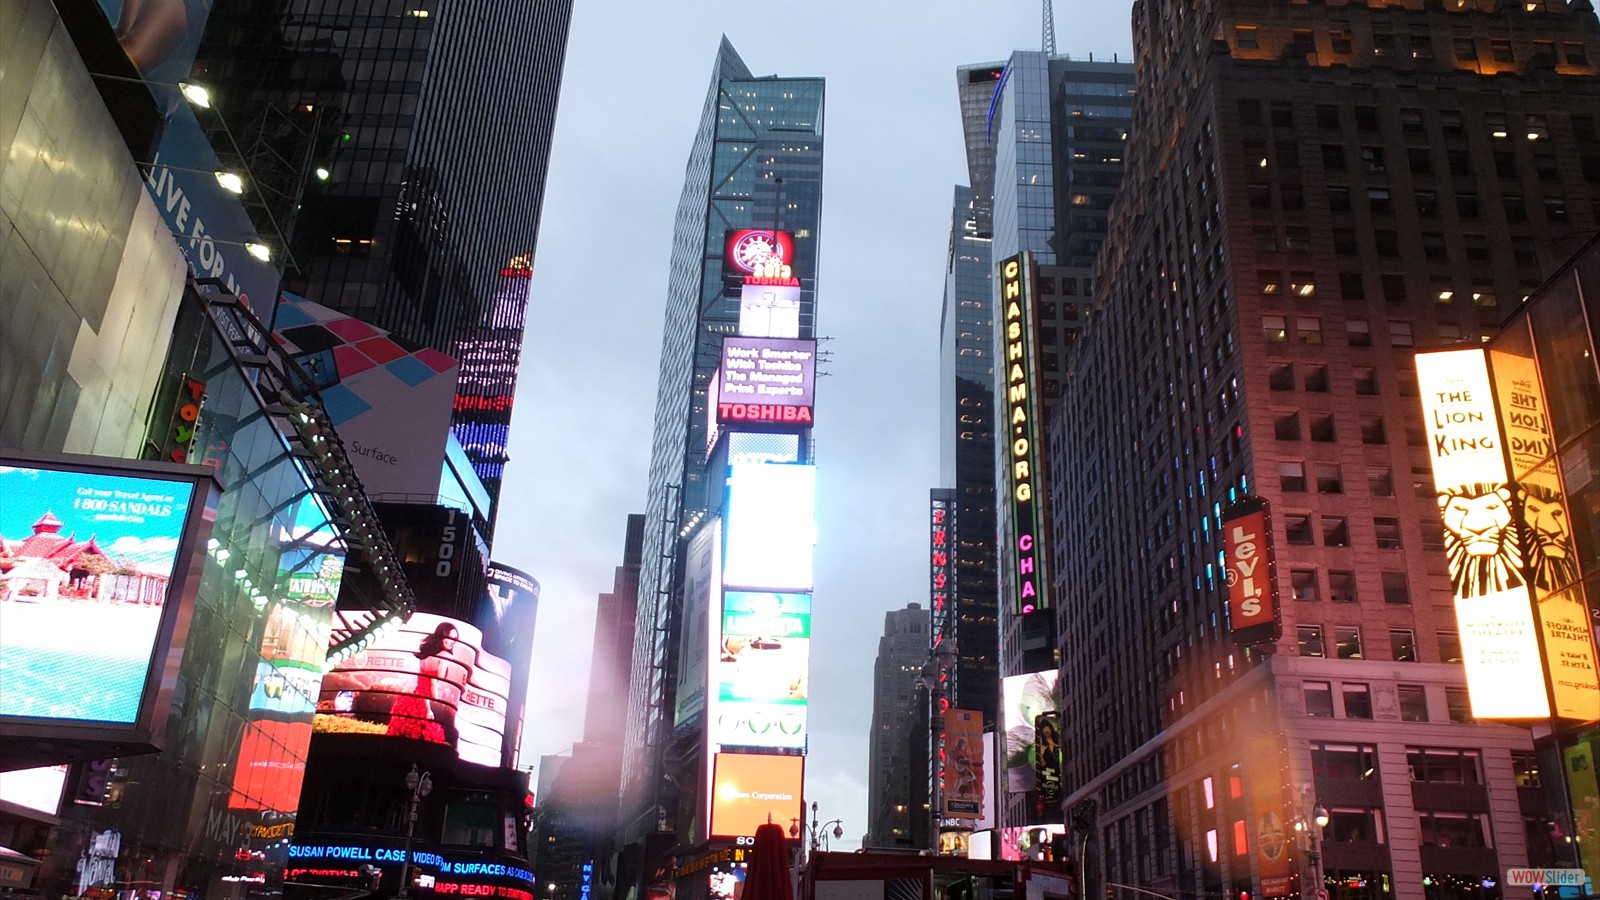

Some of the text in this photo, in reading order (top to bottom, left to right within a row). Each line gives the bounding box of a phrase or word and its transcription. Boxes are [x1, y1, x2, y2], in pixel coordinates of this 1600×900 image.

[143, 152, 191, 233] LIVE
[190, 217, 225, 279] FOR
[744, 275, 800, 286] TOSHIBA
[727, 347, 759, 358] Work
[726, 359, 756, 369] With
[725, 370, 747, 381] The
[1004, 260, 1032, 502] CHASHAMA.ORG
[724, 383, 755, 394] Print
[1436, 391, 1472, 403] THE
[718, 403, 812, 422] TOSHIBA
[1434, 409, 1483, 429] LION
[1434, 434, 1494, 457] KING
[351, 440, 397, 465] Surface
[436, 509, 456, 577] 1500
[933, 509, 946, 611] ERNST
[752, 791, 793, 801] Corporation
[945, 818, 960, 826] NBC
[736, 836, 755, 845] SO
[289, 846, 325, 857] SUSAN
[326, 846, 372, 859] POWELL
[375, 848, 406, 861] CASE
[413, 851, 435, 864] VIDEO
[454, 862, 506, 876] SURFACES
[460, 884, 496, 896] READY
